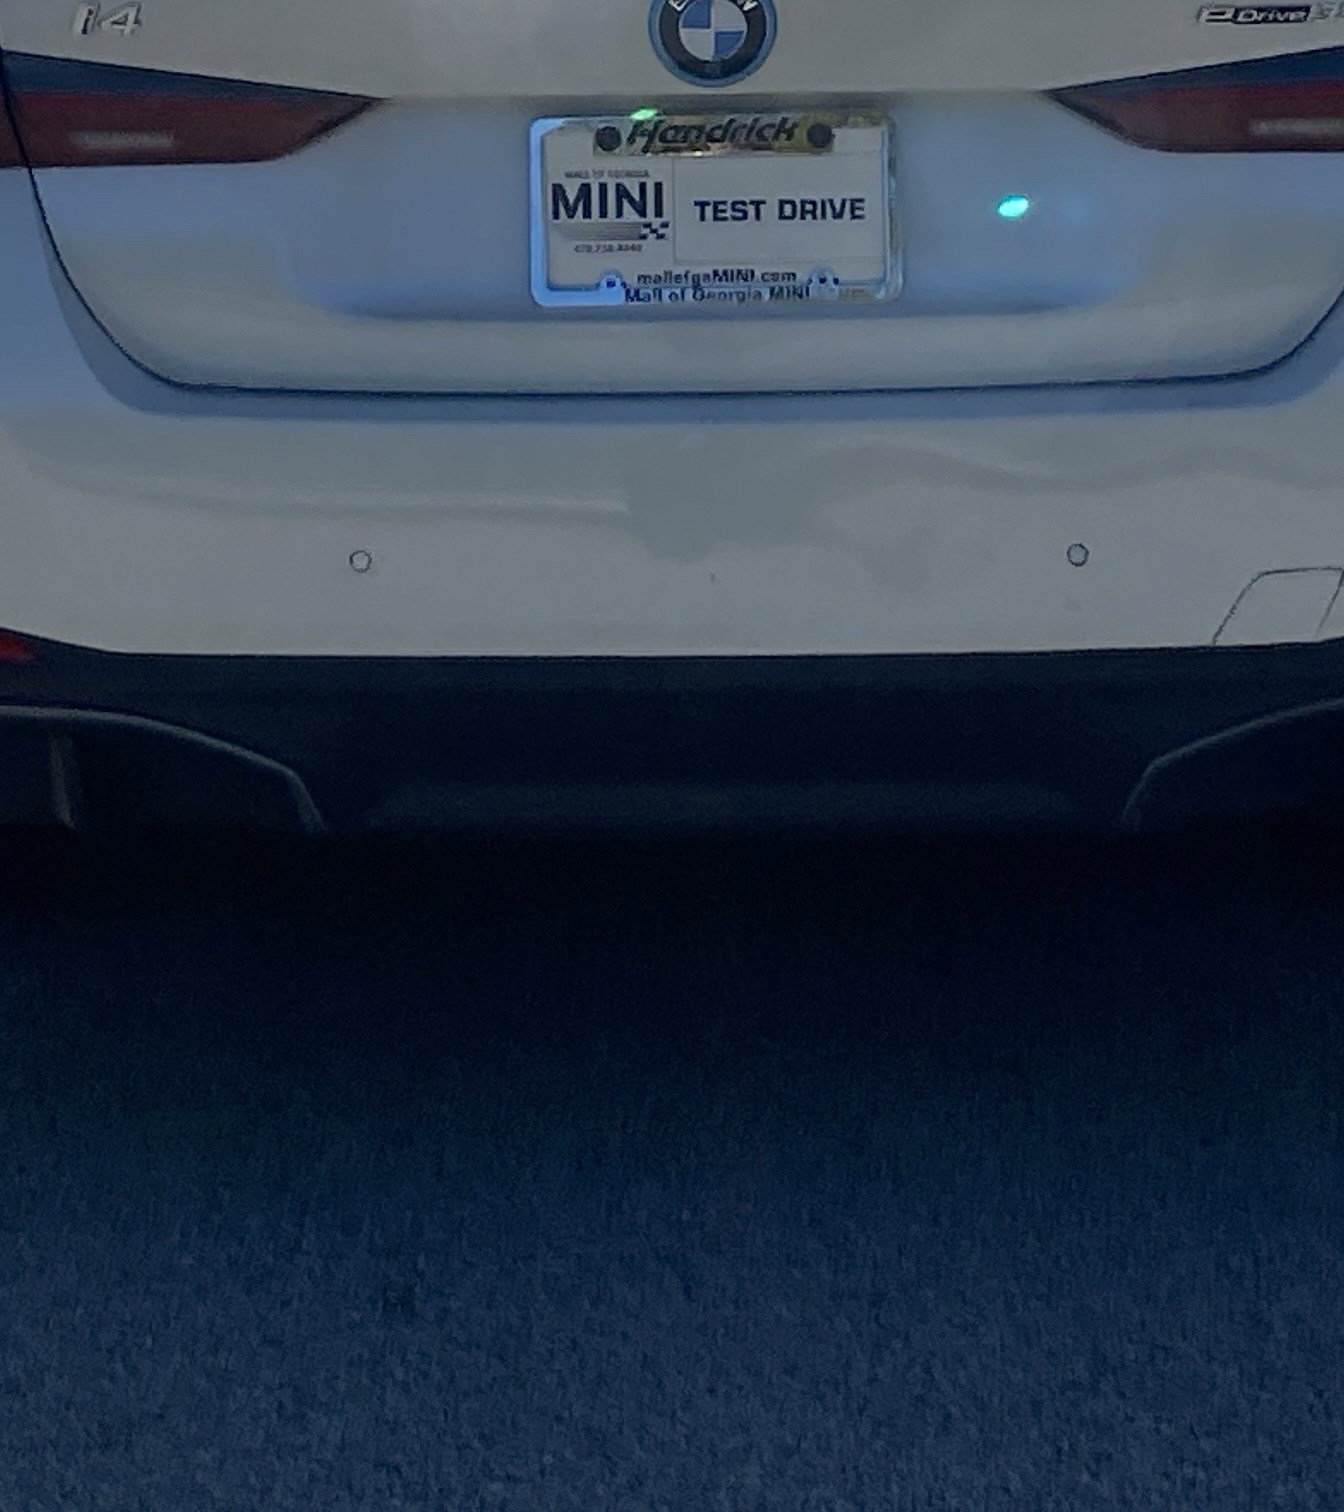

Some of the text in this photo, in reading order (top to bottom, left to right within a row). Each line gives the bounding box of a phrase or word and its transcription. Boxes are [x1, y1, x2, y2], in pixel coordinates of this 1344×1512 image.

[626, 116, 800, 154] Hendrick
[551, 181, 664, 220] MINI
[693, 197, 866, 222] TEST DRIVE
[625, 286, 811, 304] Mall of Georgia MINI
